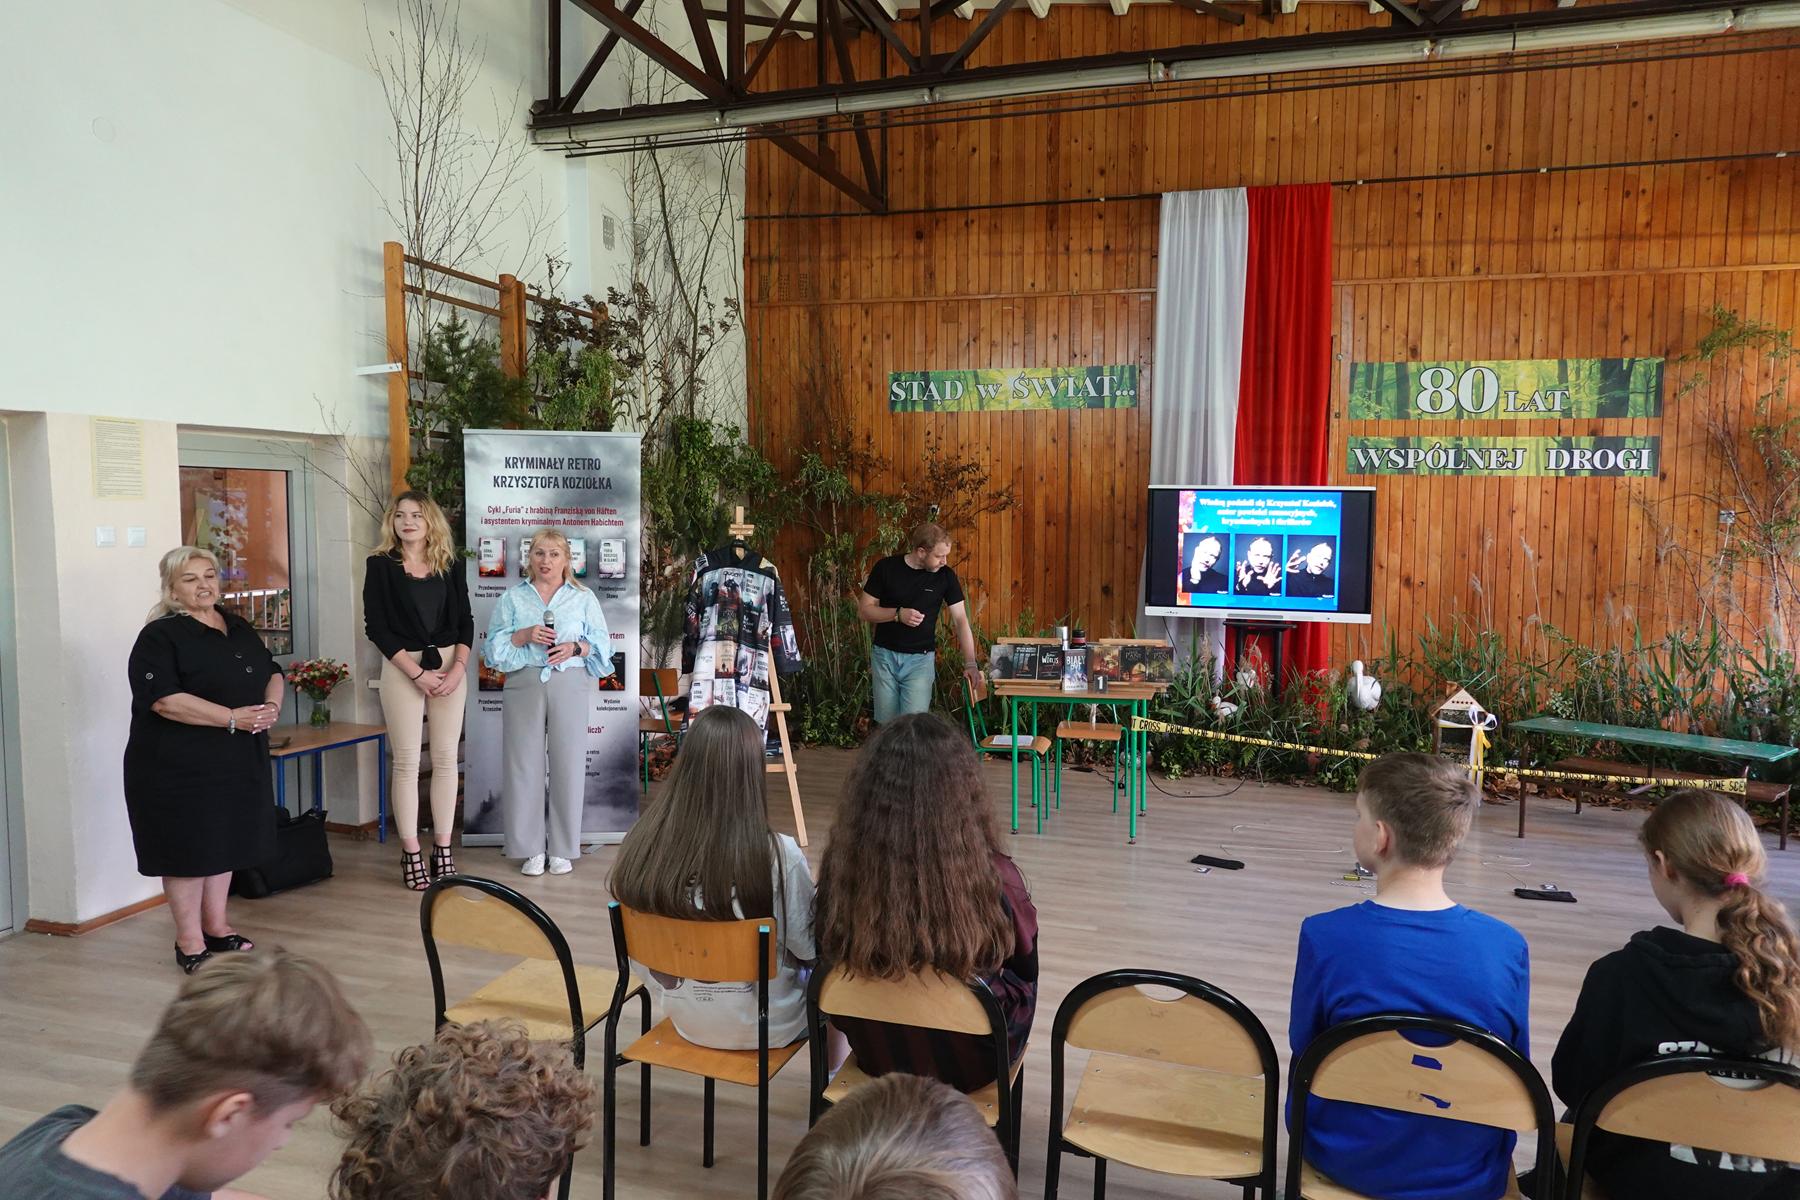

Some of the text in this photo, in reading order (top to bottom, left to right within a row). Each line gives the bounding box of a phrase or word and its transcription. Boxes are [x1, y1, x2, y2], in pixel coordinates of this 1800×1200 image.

[890, 371, 1135, 405] STĄD w ŚWIAT...
[1416, 366, 1570, 414] 80 LAT
[504, 456, 601, 470] KRYMINAŁY RETRO
[1351, 442, 1653, 471] WSPÓLNEJ DROGI
[493, 475, 612, 490] KRZYSZTOFA KOZIOŁKA
[487, 505, 501, 515] Cykl
[529, 506, 553, 516] hrabiną
[484, 518, 520, 527] asystentem
[521, 518, 561, 527] kryminalnym
[562, 518, 590, 526] Antonem
[591, 518, 624, 527] Habichtem
[1097, 676, 1104, 690] 1
[1139, 719, 1161, 732] CROSS
[1703, 780, 1725, 792] CRIME
